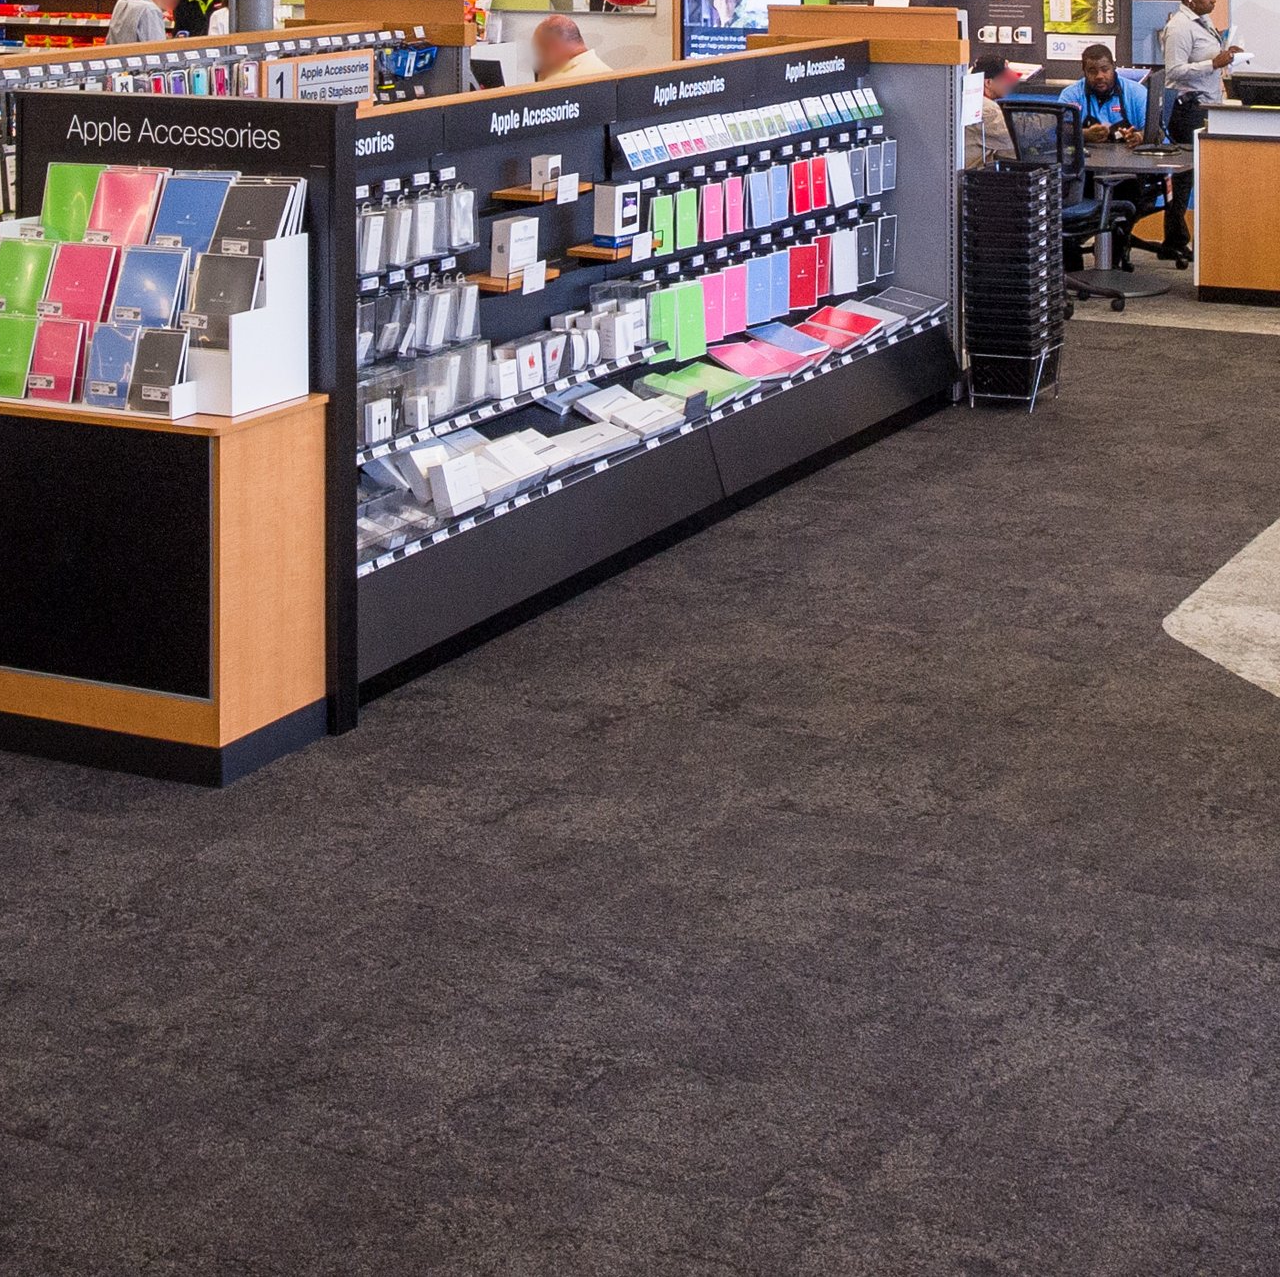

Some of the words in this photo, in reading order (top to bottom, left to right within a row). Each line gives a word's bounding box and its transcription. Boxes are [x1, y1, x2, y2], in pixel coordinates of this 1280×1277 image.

[300, 63, 330, 82] Apple
[331, 59, 370, 79] Accessories
[785, 62, 805, 83] Apple
[806, 55, 846, 77] Accessories
[275, 72, 286, 99] 1
[300, 87, 320, 100] More
[320, 85, 328, 98] @
[327, 83, 369, 99] Staples.com
[653, 82, 677, 106] Apple
[678, 75, 725, 100] Accessories
[490, 108, 521, 134] Apple
[525, 100, 580, 128] Accessories
[66, 114, 132, 146] Apple
[137, 118, 281, 151] Accessories
